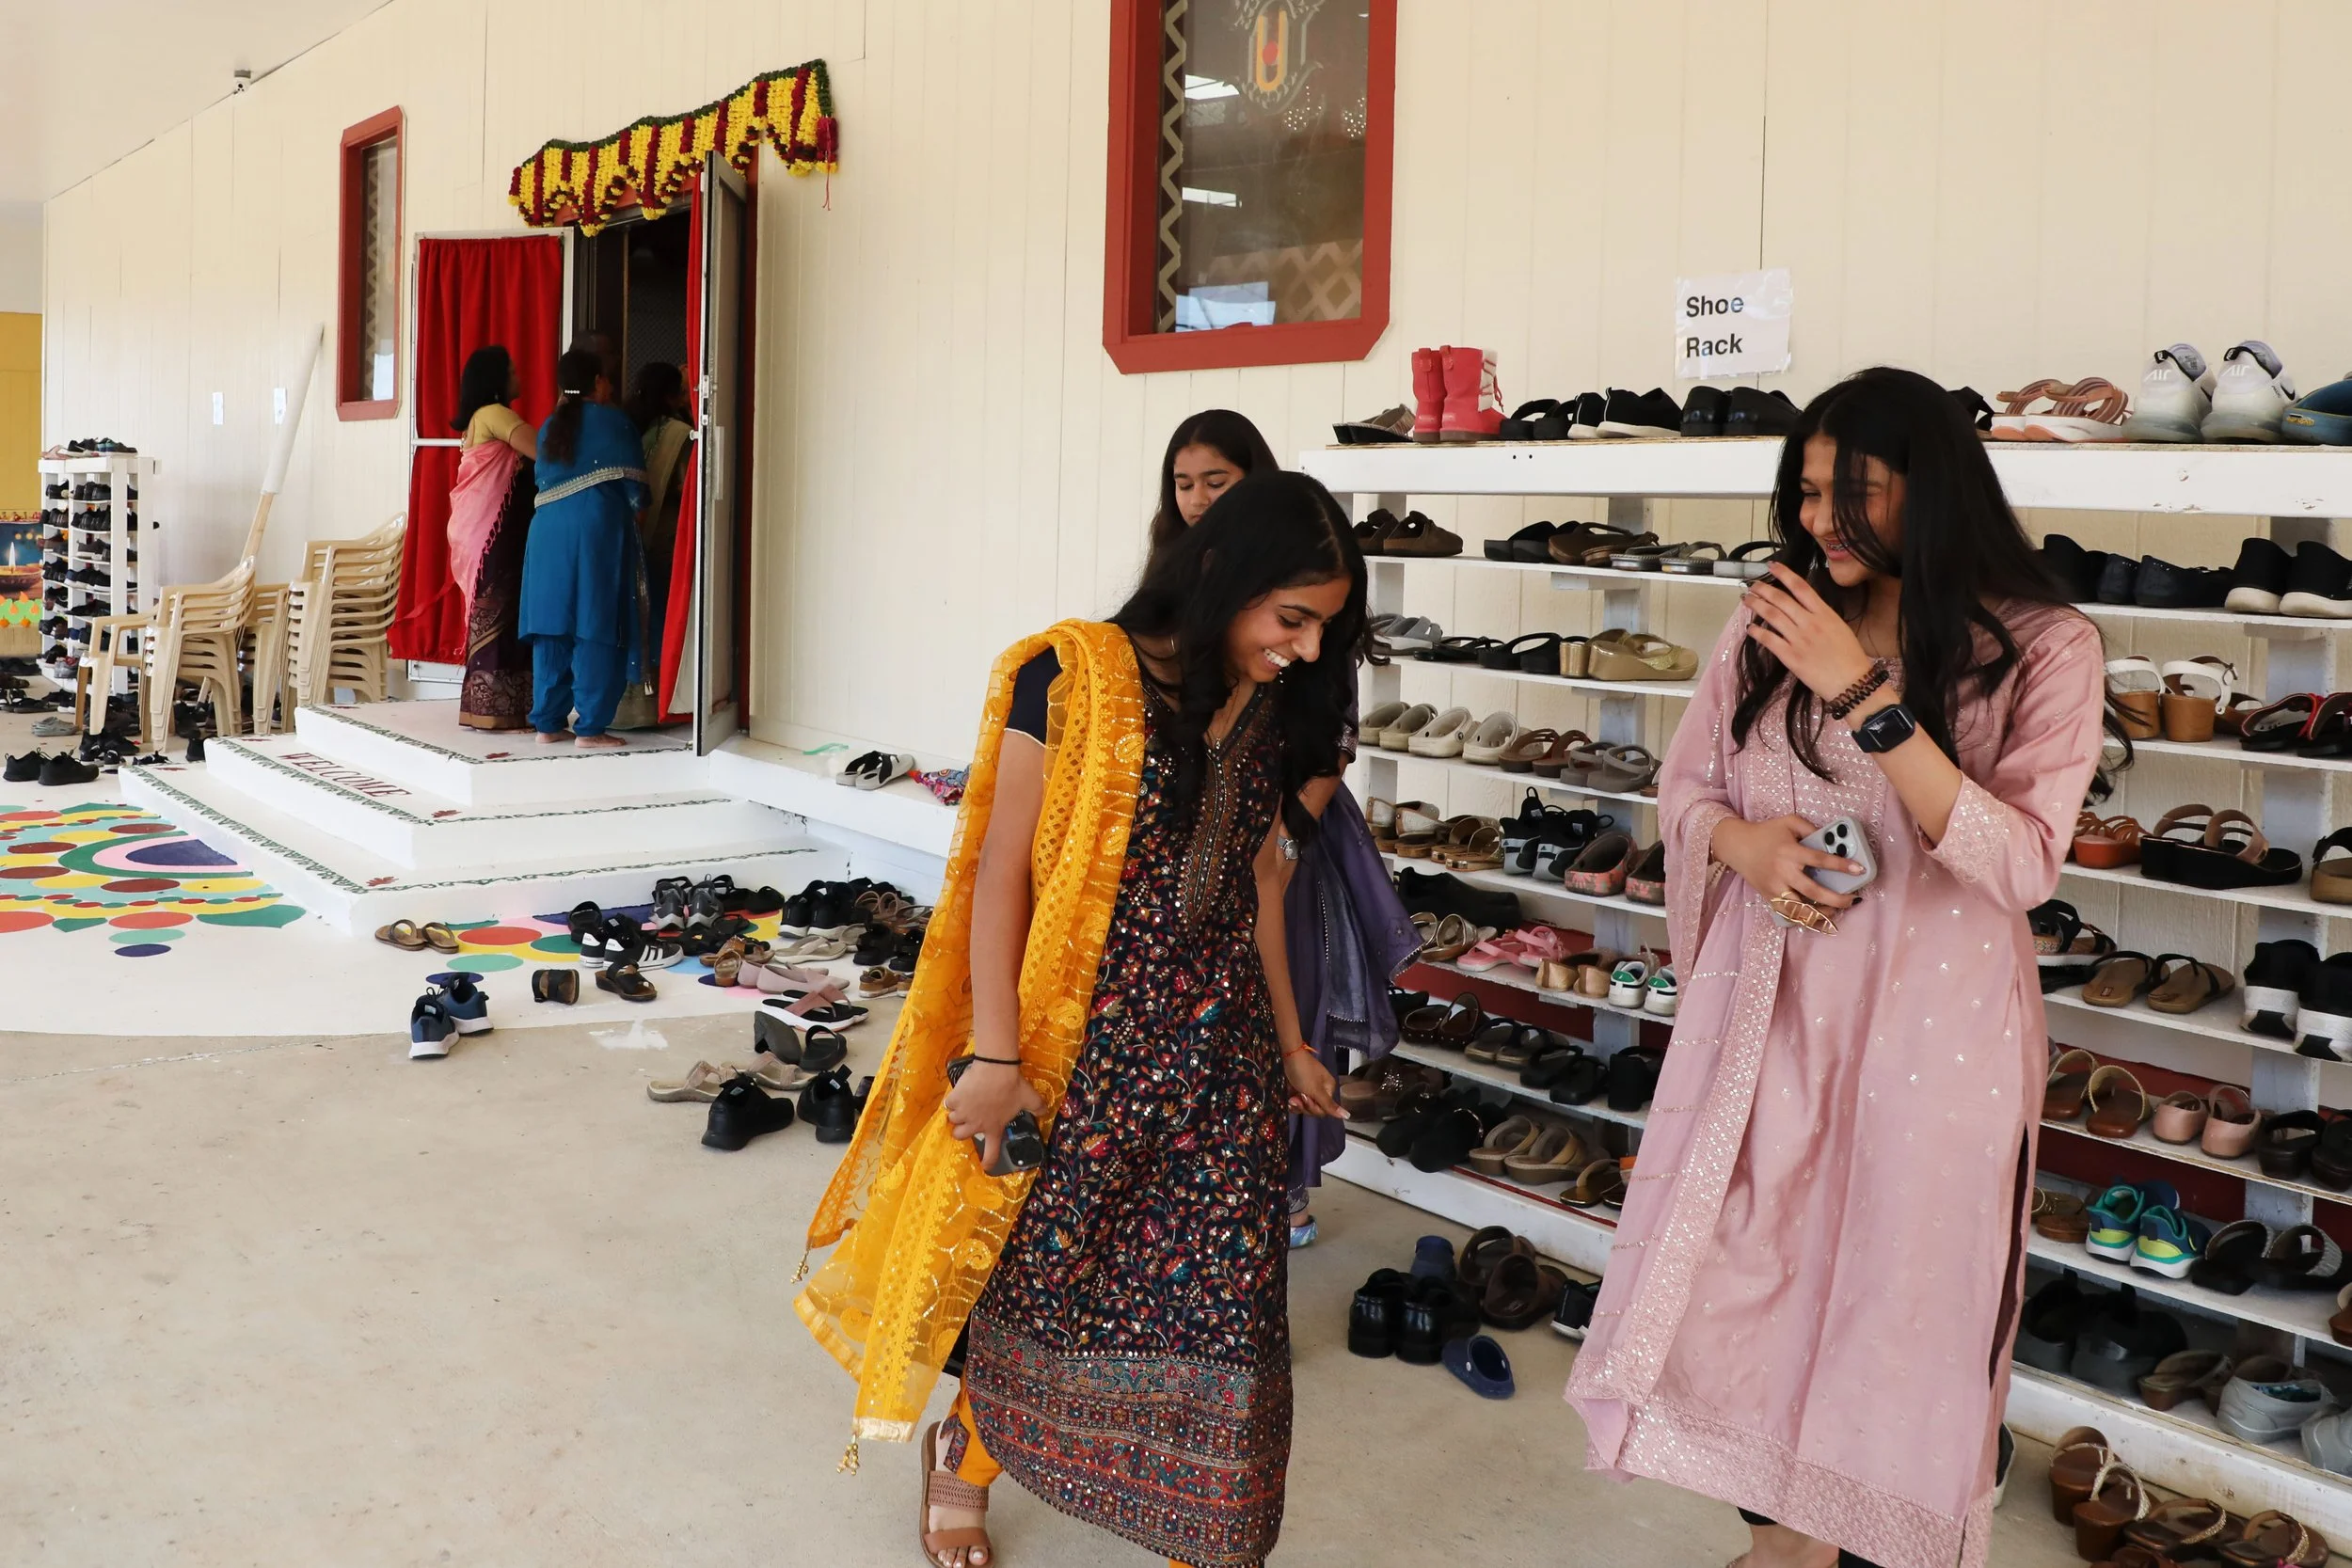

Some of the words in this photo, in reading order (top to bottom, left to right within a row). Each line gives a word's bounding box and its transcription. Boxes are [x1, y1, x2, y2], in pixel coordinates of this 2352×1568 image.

[1686, 295, 1744, 318] Shoe
[1686, 333, 1743, 358] Rack
[278, 752, 413, 798] WELCOME
